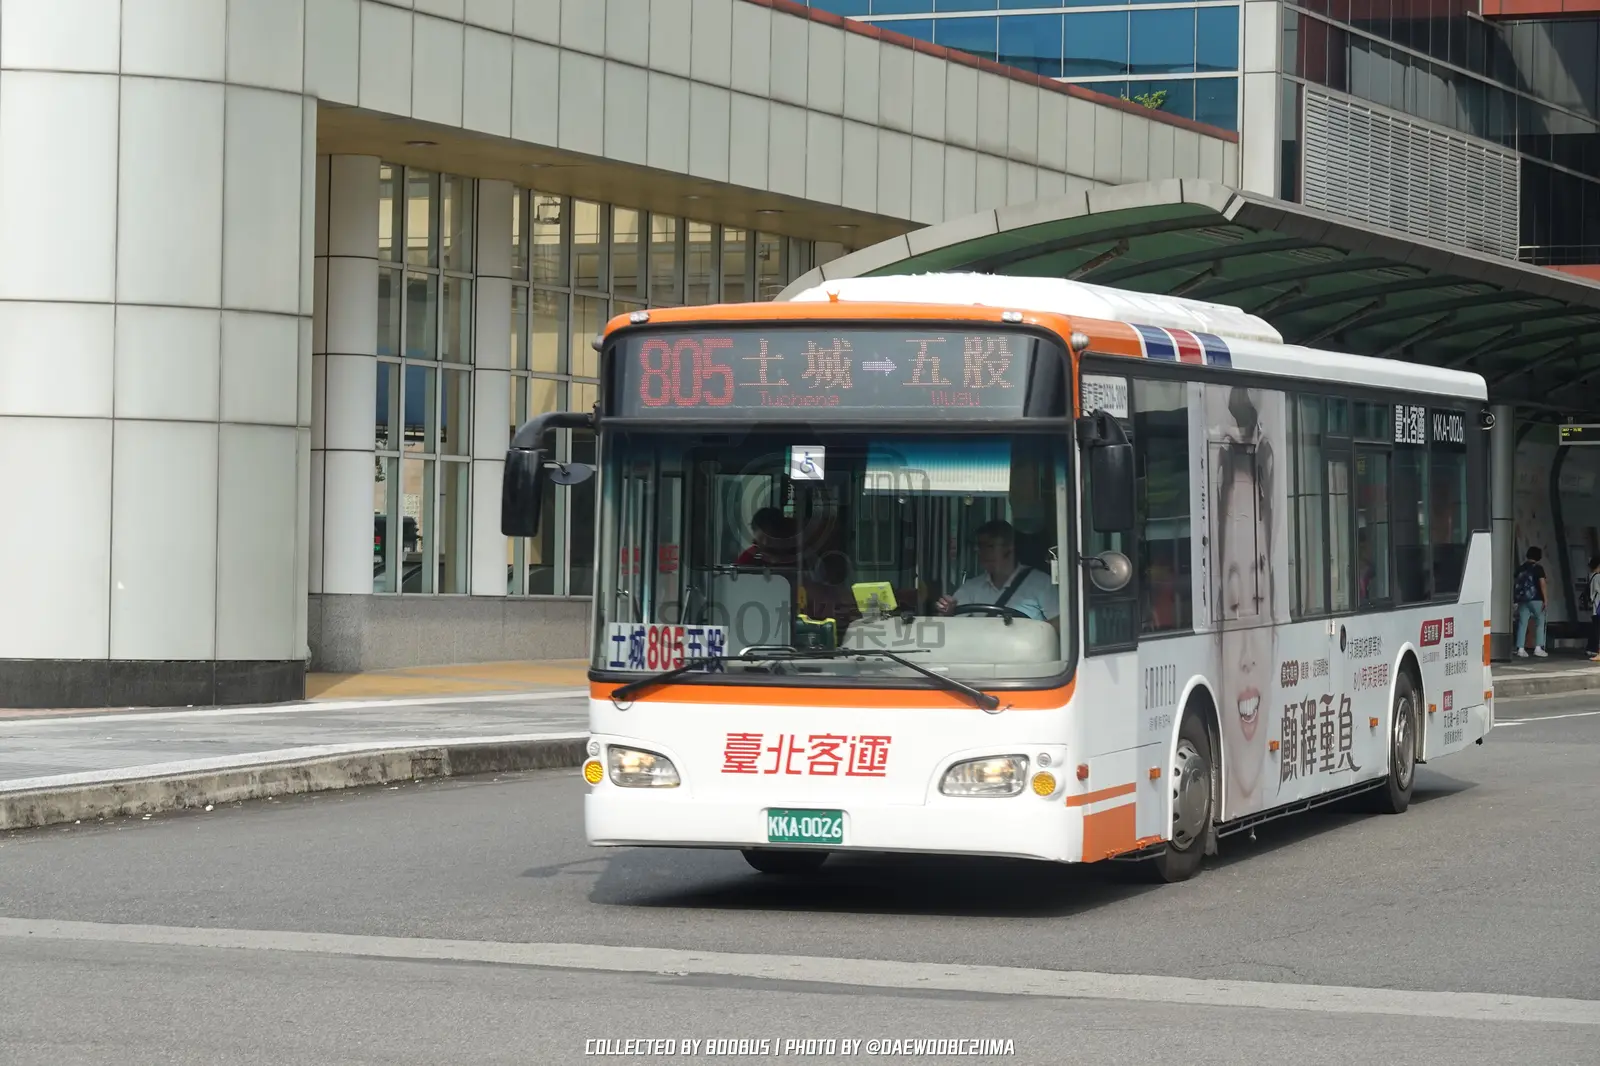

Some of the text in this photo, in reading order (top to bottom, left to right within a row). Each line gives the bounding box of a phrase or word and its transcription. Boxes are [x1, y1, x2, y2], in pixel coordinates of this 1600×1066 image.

[640, 336, 1015, 407] 805 土城 五股
[1395, 404, 1425, 445] 臺北客運
[1433, 413, 1464, 443] KKA-0026
[721, 732, 892, 777] 臺北客運
[768, 816, 842, 839] KKA-0026
